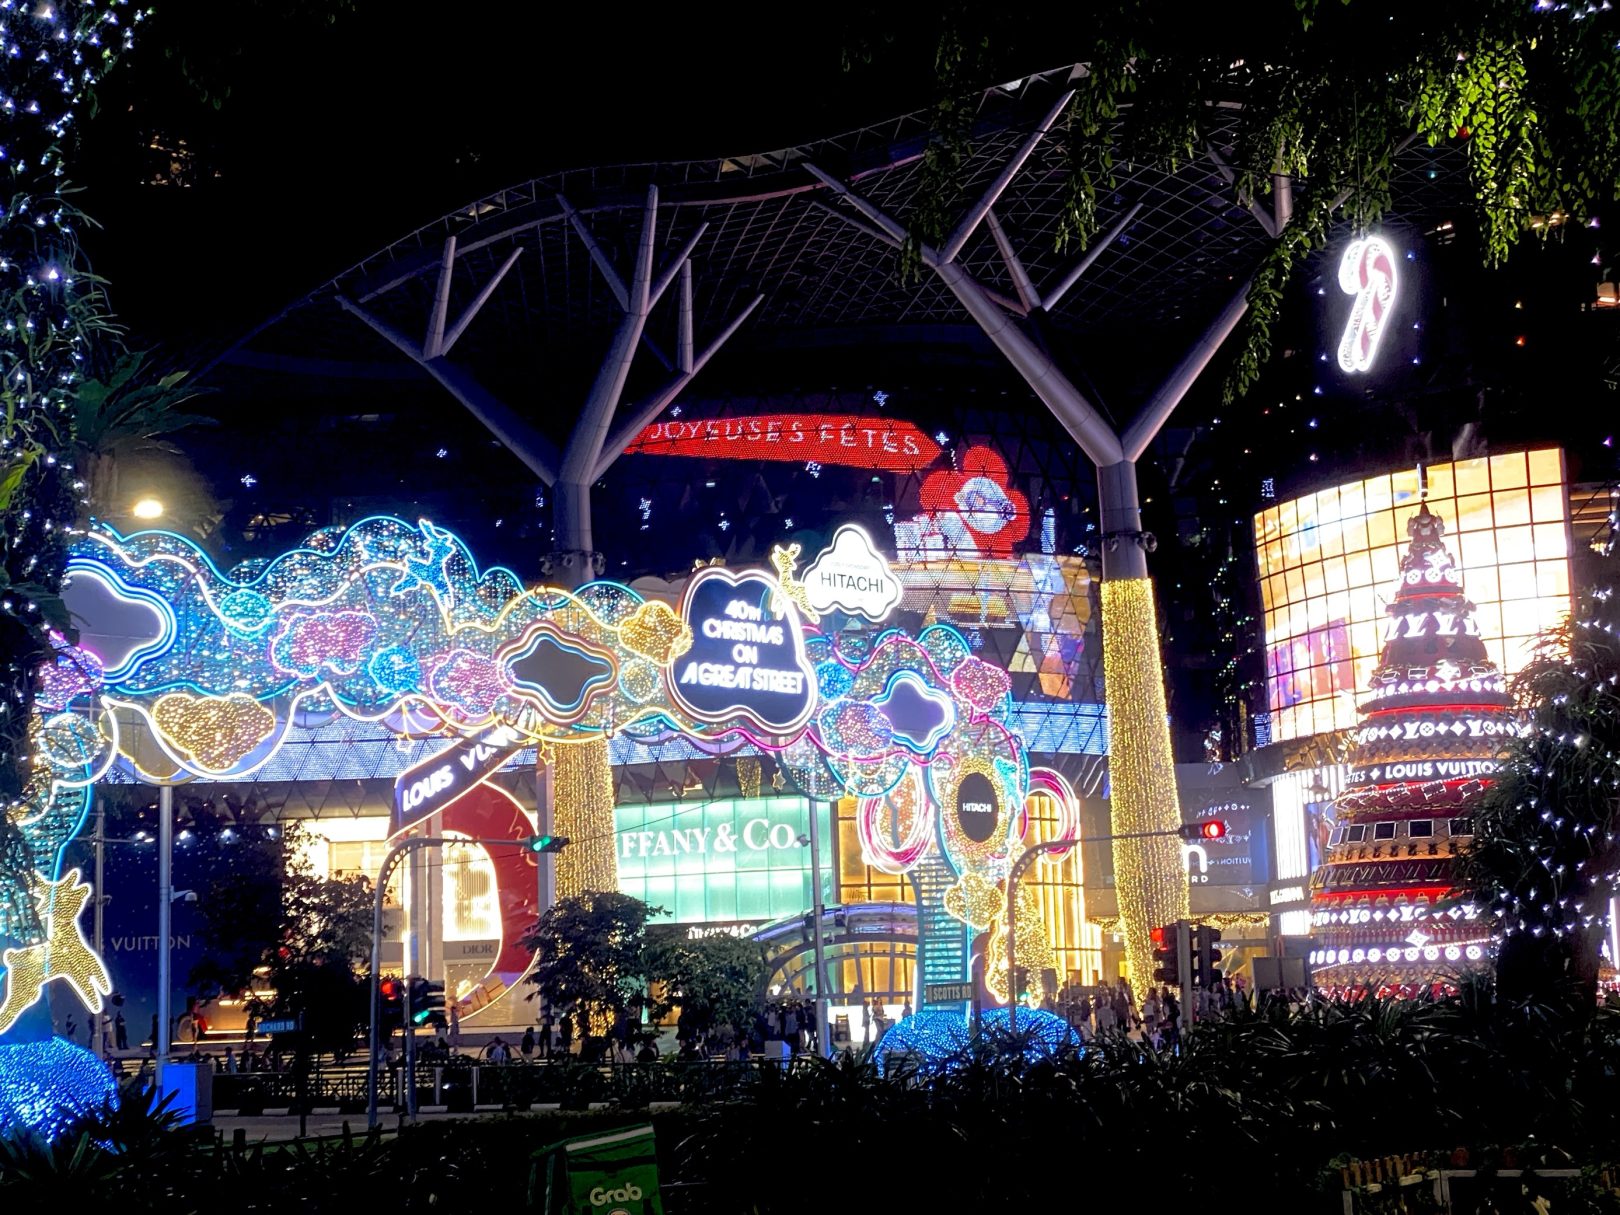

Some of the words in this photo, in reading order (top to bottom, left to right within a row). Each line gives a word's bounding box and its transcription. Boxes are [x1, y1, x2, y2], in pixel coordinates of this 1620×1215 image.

[651, 420, 804, 442] JOYEUSES
[821, 572, 884, 593] HITACHI
[702, 618, 784, 645] CHRISTMAS
[732, 643, 758, 664] ON
[680, 662, 698, 684] A
[699, 662, 752, 689] GREAT
[753, 668, 804, 694] STREET
[1386, 764, 1434, 780] LOUIS
[1436, 761, 1503, 777] VUITTO
[403, 765, 454, 812] LOUIS
[962, 803, 992, 812] HITACHI
[713, 821, 739, 853] &
[462, 944, 493, 955] DIOR
[933, 986, 960, 1000] SCOTTS
[590, 1182, 642, 1207] Grab
